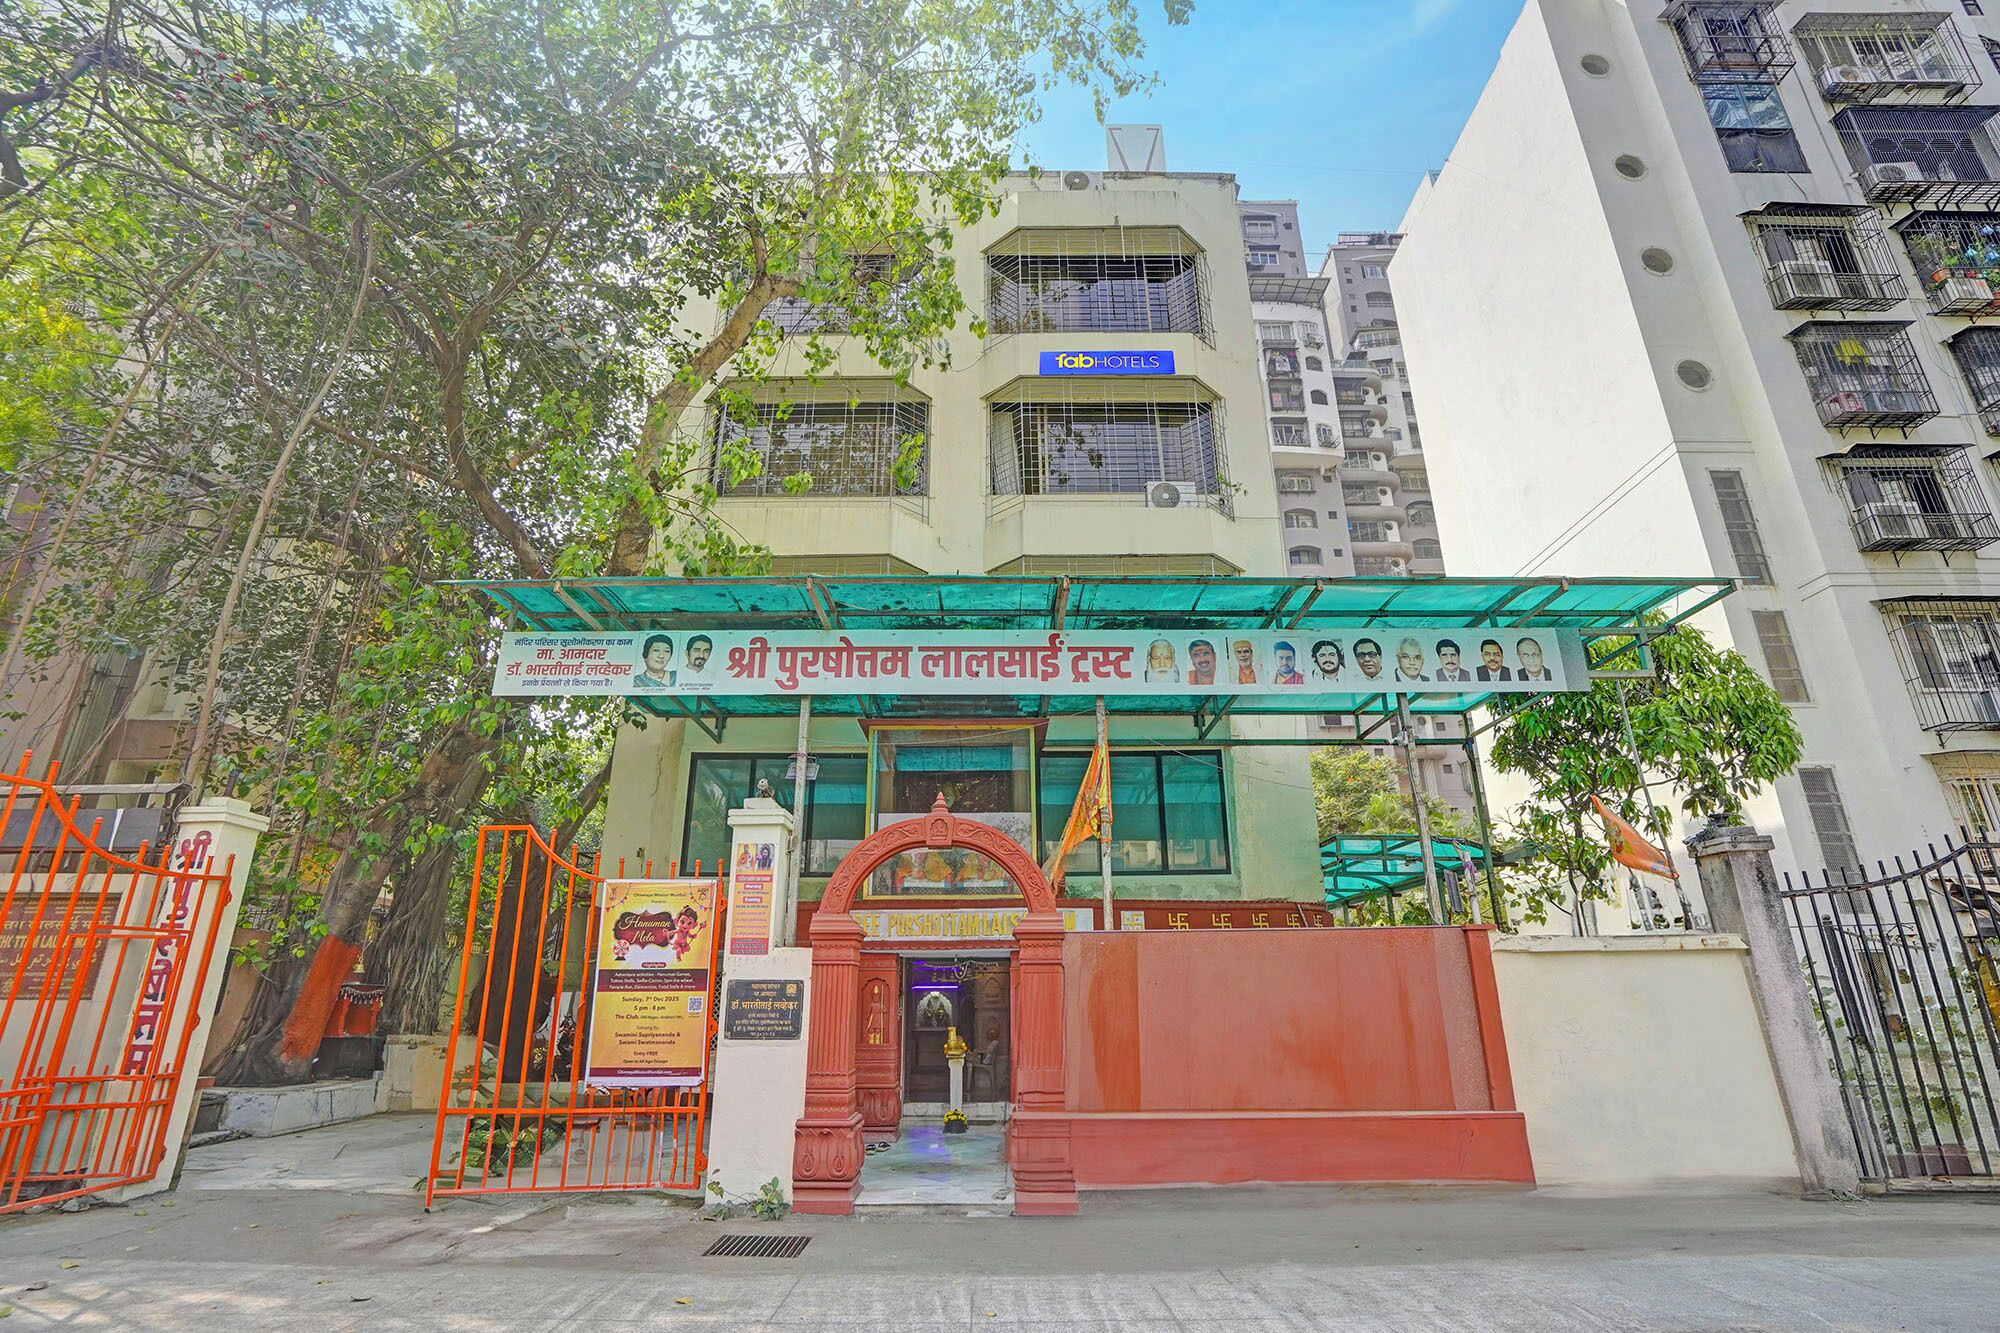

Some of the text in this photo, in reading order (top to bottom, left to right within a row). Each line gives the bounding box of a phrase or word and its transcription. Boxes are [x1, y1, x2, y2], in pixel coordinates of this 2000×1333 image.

[1056, 353, 1160, 369] fabHOTELS
[514, 637, 533, 646] मंदिर
[534, 637, 558, 646] परिसर
[605, 638, 615, 646] का
[616, 638, 633, 646] काम
[536, 648, 607, 660] मा. आमदार
[726, 636, 771, 678] श्री
[1067, 646, 1135, 683] ट्रस्ट
[506, 661, 633, 676] डॉ. भारतीताई लव्हेकर
[521, 678, 539, 687] इनके
[563, 678, 570, 687] से
[571, 678, 588, 687] किया
[590, 679, 603, 687] गया
[176, 830, 212, 869] श्री
[620, 915, 671, 930] Hanuman
[888, 912, 979, 937] PURSHOTTAM
[630, 931, 655, 944] Mela
